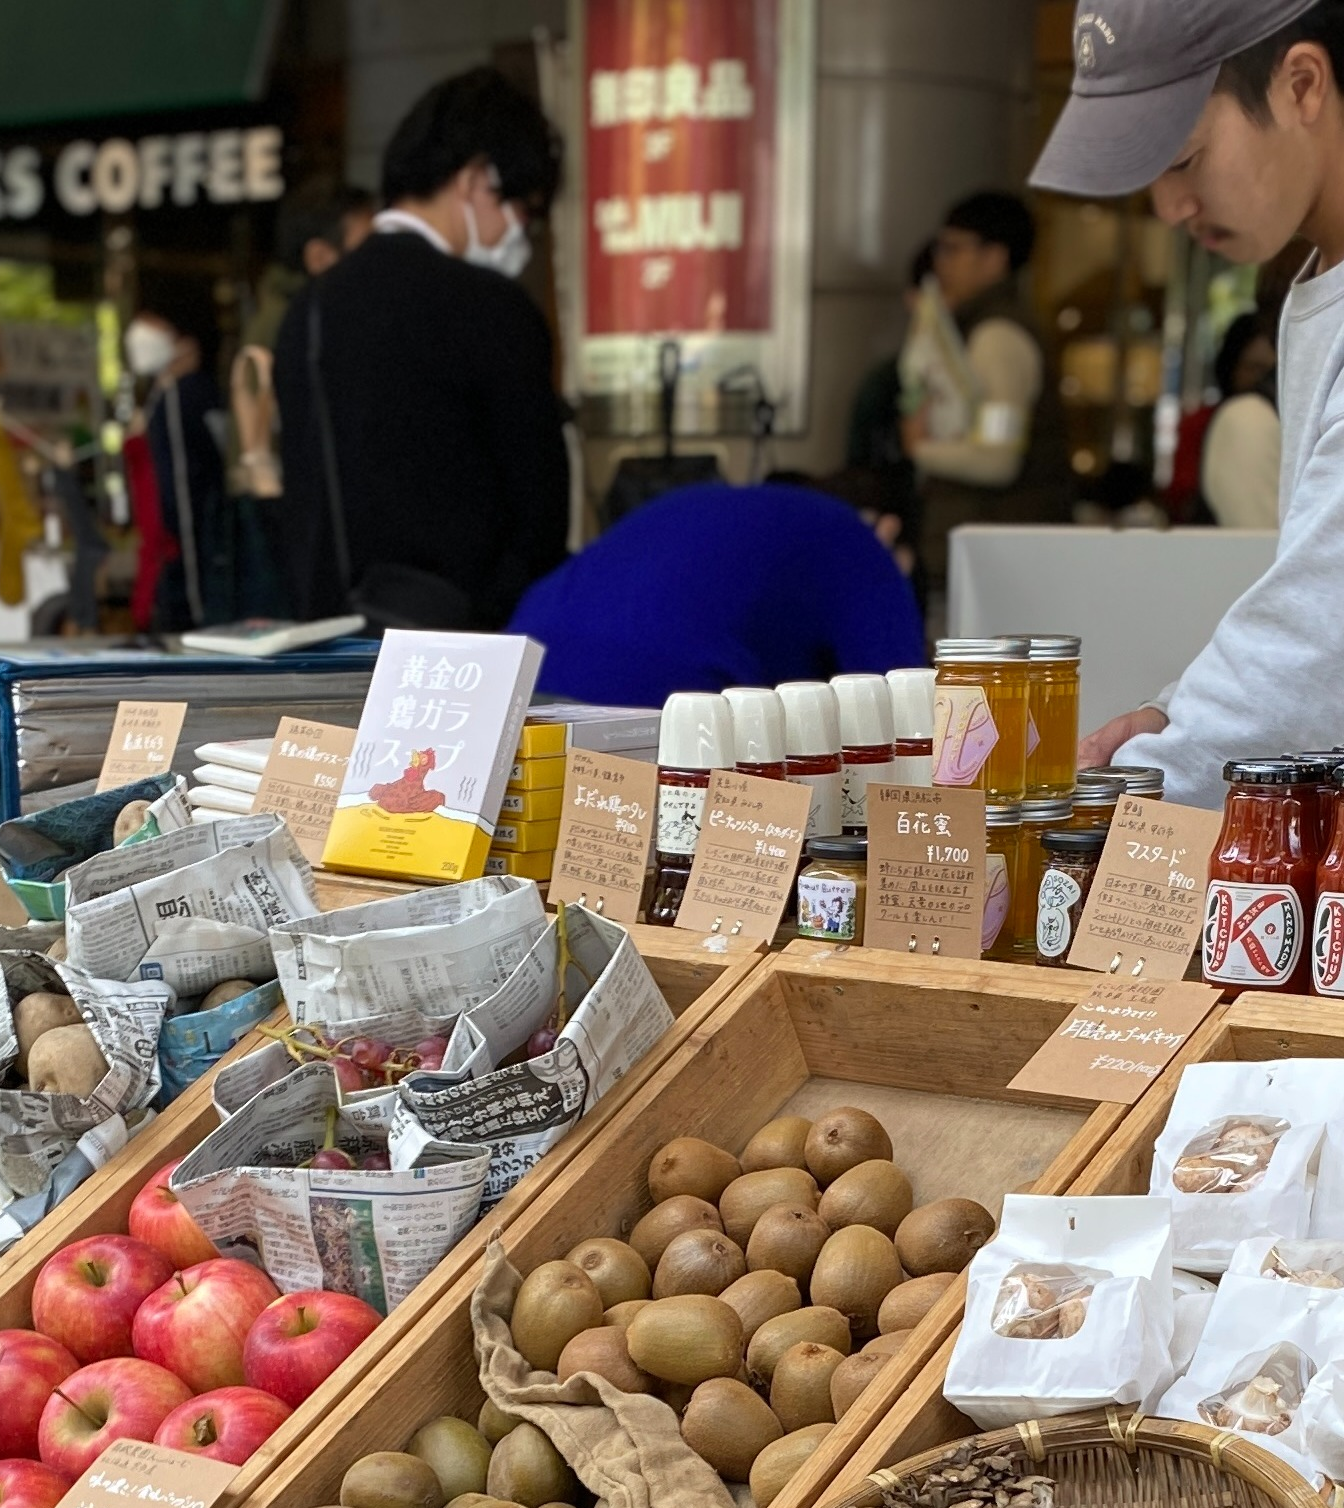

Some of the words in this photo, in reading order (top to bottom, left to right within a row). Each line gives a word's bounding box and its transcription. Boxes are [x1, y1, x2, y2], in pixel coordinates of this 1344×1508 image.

[56, 125, 285, 217] COFFEE
[398, 654, 483, 692] 黄金の
[384, 694, 473, 732] 鶏ガラ
[373, 738, 466, 773] スプ
[896, 811, 952, 838] 百花蜜
[926, 844, 970, 864] ¥1,700
[1125, 841, 1187, 868] マスタード
[1167, 870, 1196, 890] ¥910
[1210, 894, 1228, 969] KETCHUP
[1324, 906, 1343, 983] KETCHUP
